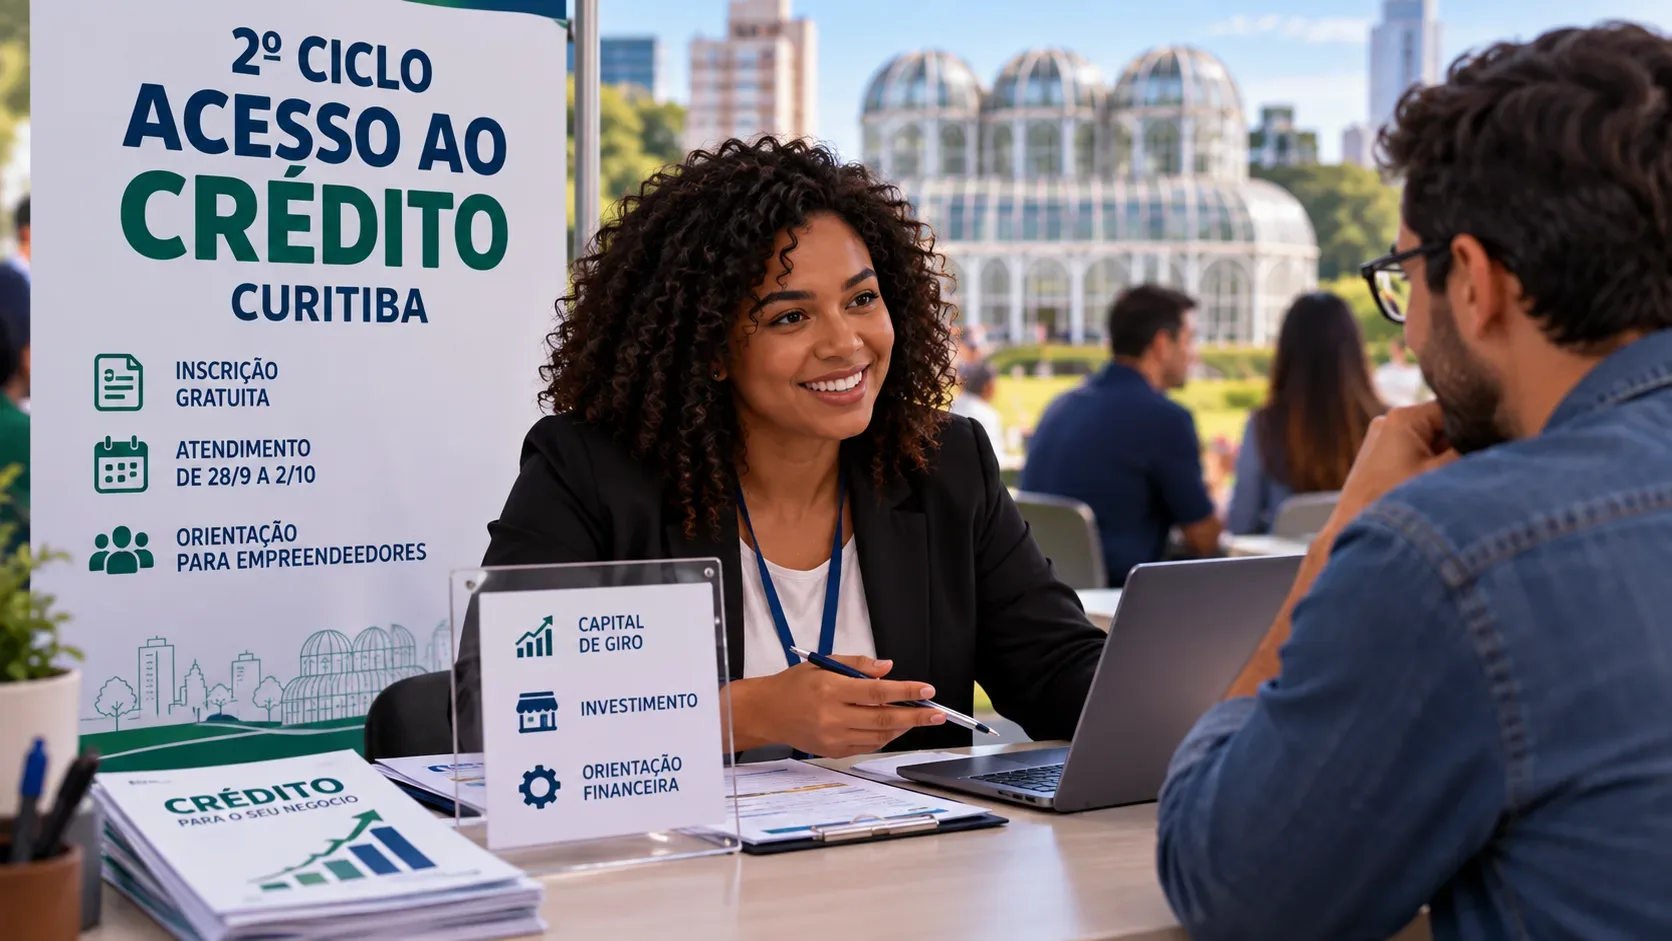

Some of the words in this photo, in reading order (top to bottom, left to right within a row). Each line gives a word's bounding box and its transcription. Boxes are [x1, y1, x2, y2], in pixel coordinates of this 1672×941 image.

[298, 36, 433, 94] CICLO
[122, 83, 401, 168] ACESSO
[418, 113, 507, 176] AO
[120, 165, 509, 271] CRÉDITO
[231, 283, 429, 324] CURITIBA
[176, 357, 278, 384] INSCRIÇÃO
[176, 388, 270, 408] GRATUITA
[176, 439, 311, 460] ATENDIMENTO
[177, 467, 202, 487] DE
[208, 466, 251, 487] 28/9
[256, 467, 270, 485] A
[275, 465, 316, 486] 2/10
[176, 520, 298, 548] ORIENTAÇÃO
[177, 552, 231, 573] PARA
[237, 543, 427, 569] EMPREENDEEDORES
[578, 615, 645, 632] CAPITAL
[579, 638, 600, 653] DE
[605, 635, 643, 652] GIRO
[581, 693, 698, 716] INVESTIMENTO
[582, 754, 682, 780] ORIENTAÇÃO
[164, 777, 344, 814] CRÉDITO
[583, 777, 680, 801] FINANCEIRA
[178, 815, 226, 827] PARA
[229, 812, 242, 821] O
[246, 807, 280, 819] SEU
